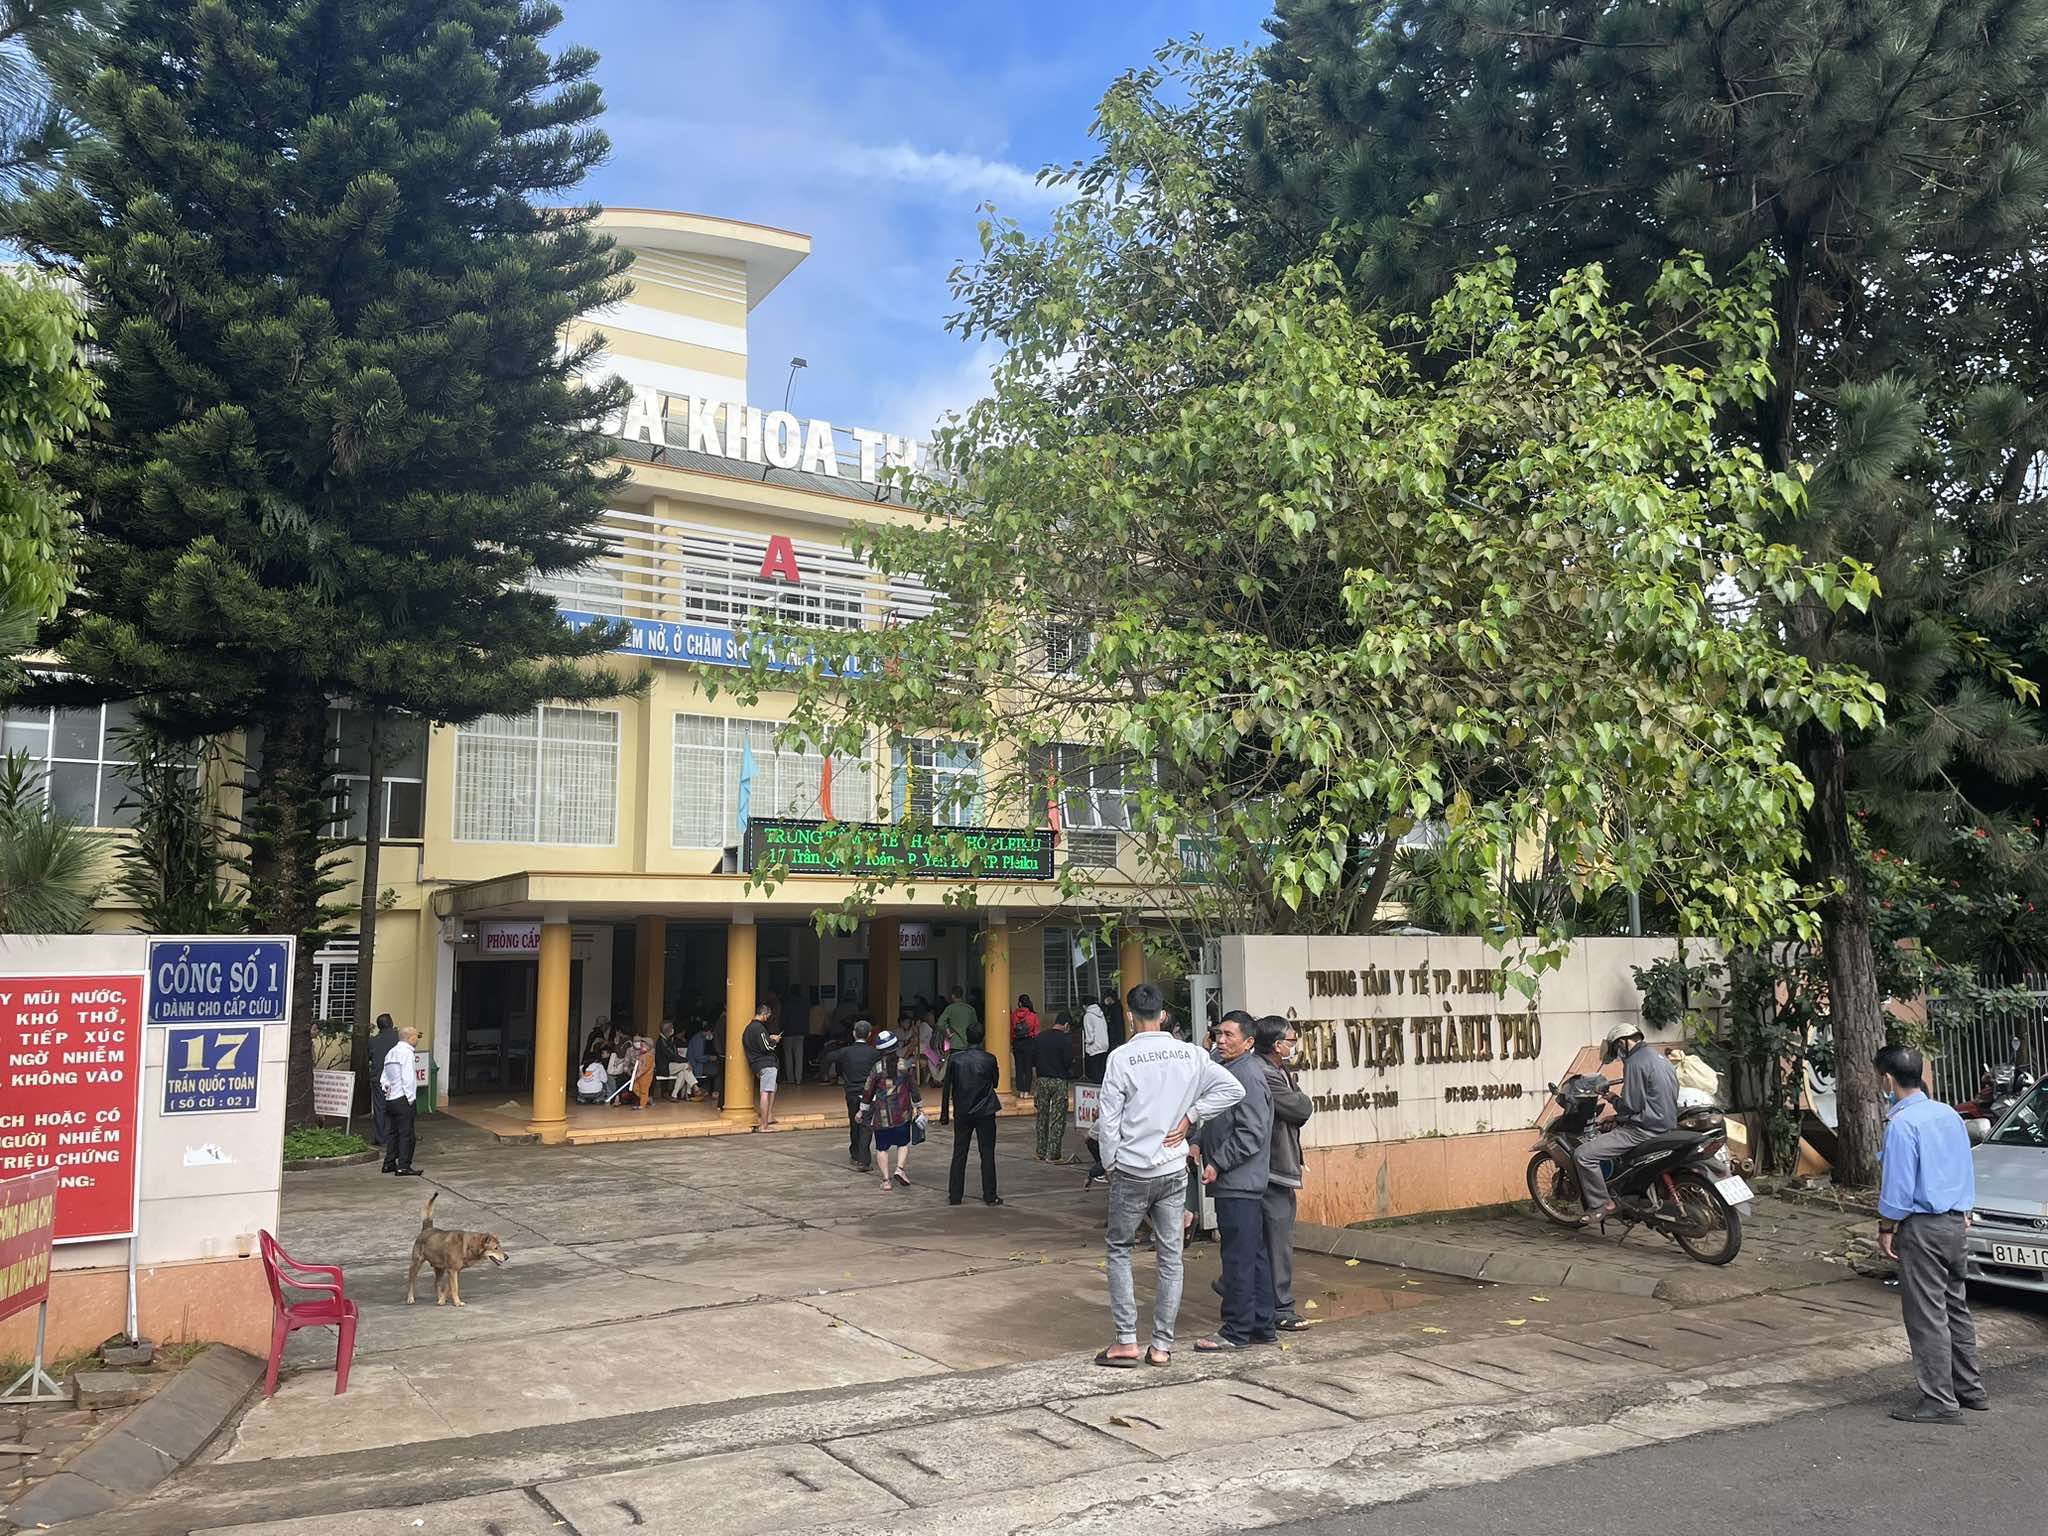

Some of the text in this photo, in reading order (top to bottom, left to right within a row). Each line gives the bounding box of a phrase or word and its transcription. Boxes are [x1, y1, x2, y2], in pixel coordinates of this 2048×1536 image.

[689, 396, 839, 477] KHOA
[759, 535, 800, 582] A
[649, 624, 669, 654] NỞ,
[687, 633, 722, 658] CHĂM
[764, 828, 823, 845] TRUNG
[769, 848, 785, 864] 17
[792, 845, 820, 865] Trần
[487, 926, 541, 949] PHÒNG CẤP
[158, 945, 278, 994] CỔNG SỐ 1
[1306, 970, 1357, 999] TRUNG
[1394, 970, 1405, 995] Y
[24, 990, 60, 1005] MŨI
[71, 989, 127, 1005] NƯỚC,
[198, 1001, 221, 1016] CHO
[224, 995, 247, 1016] CẤP
[16, 1007, 126, 1025] KHÓ THỞ,
[20, 1028, 126, 1045] TIẾP XÚC
[1410, 1001, 1494, 1065] THÀNH
[10, 1046, 125, 1066] NGỜ NHIỄM
[178, 1032, 249, 1071] 17
[1129, 1049, 1191, 1066] BALENCAIGA
[11, 1068, 123, 1086] KHÔNG VÀO
[198, 1073, 226, 1094] QUỐC
[228, 1072, 255, 1090] TOẢN
[199, 1096, 215, 1108] CŨ
[35, 1111, 87, 1127] HOẶC
[96, 1107, 121, 1122] CÓ
[0, 1126, 120, 1149] GƯỜI NHIỄM
[55, 1149, 120, 1166] CHỨNG
